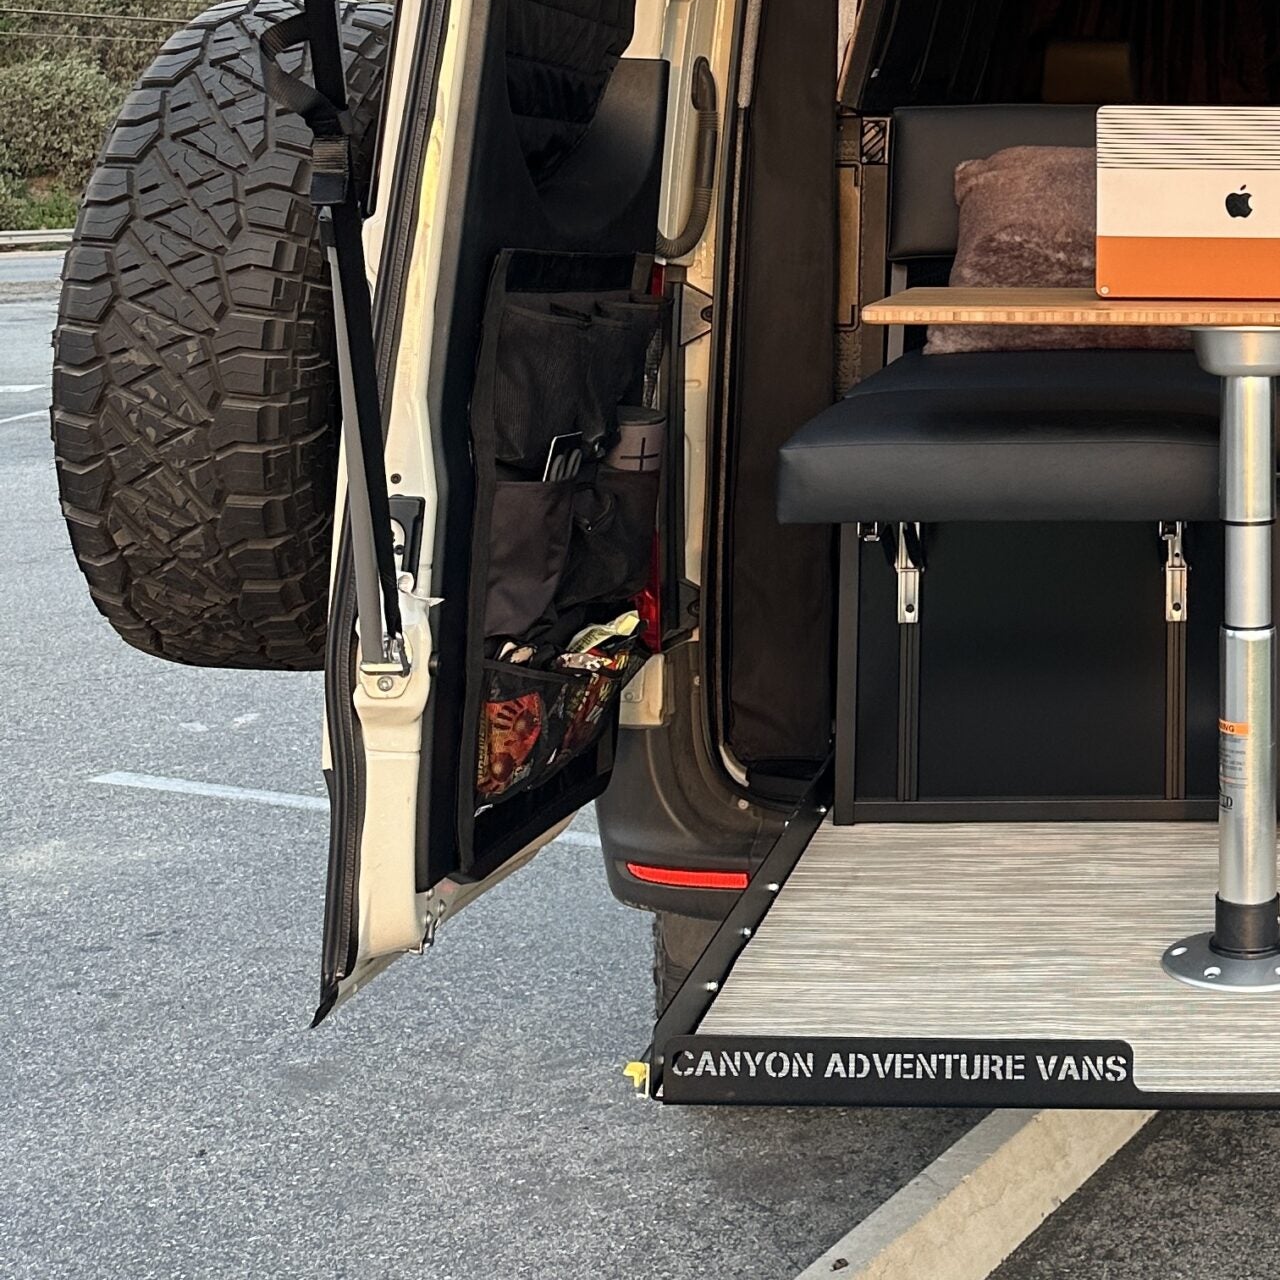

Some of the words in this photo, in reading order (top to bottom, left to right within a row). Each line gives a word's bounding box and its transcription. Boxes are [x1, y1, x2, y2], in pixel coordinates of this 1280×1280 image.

[672, 1050, 814, 1078] CANYON
[823, 1052, 1026, 1080] ADVENTURE
[1035, 1054, 1127, 1082] VANS
